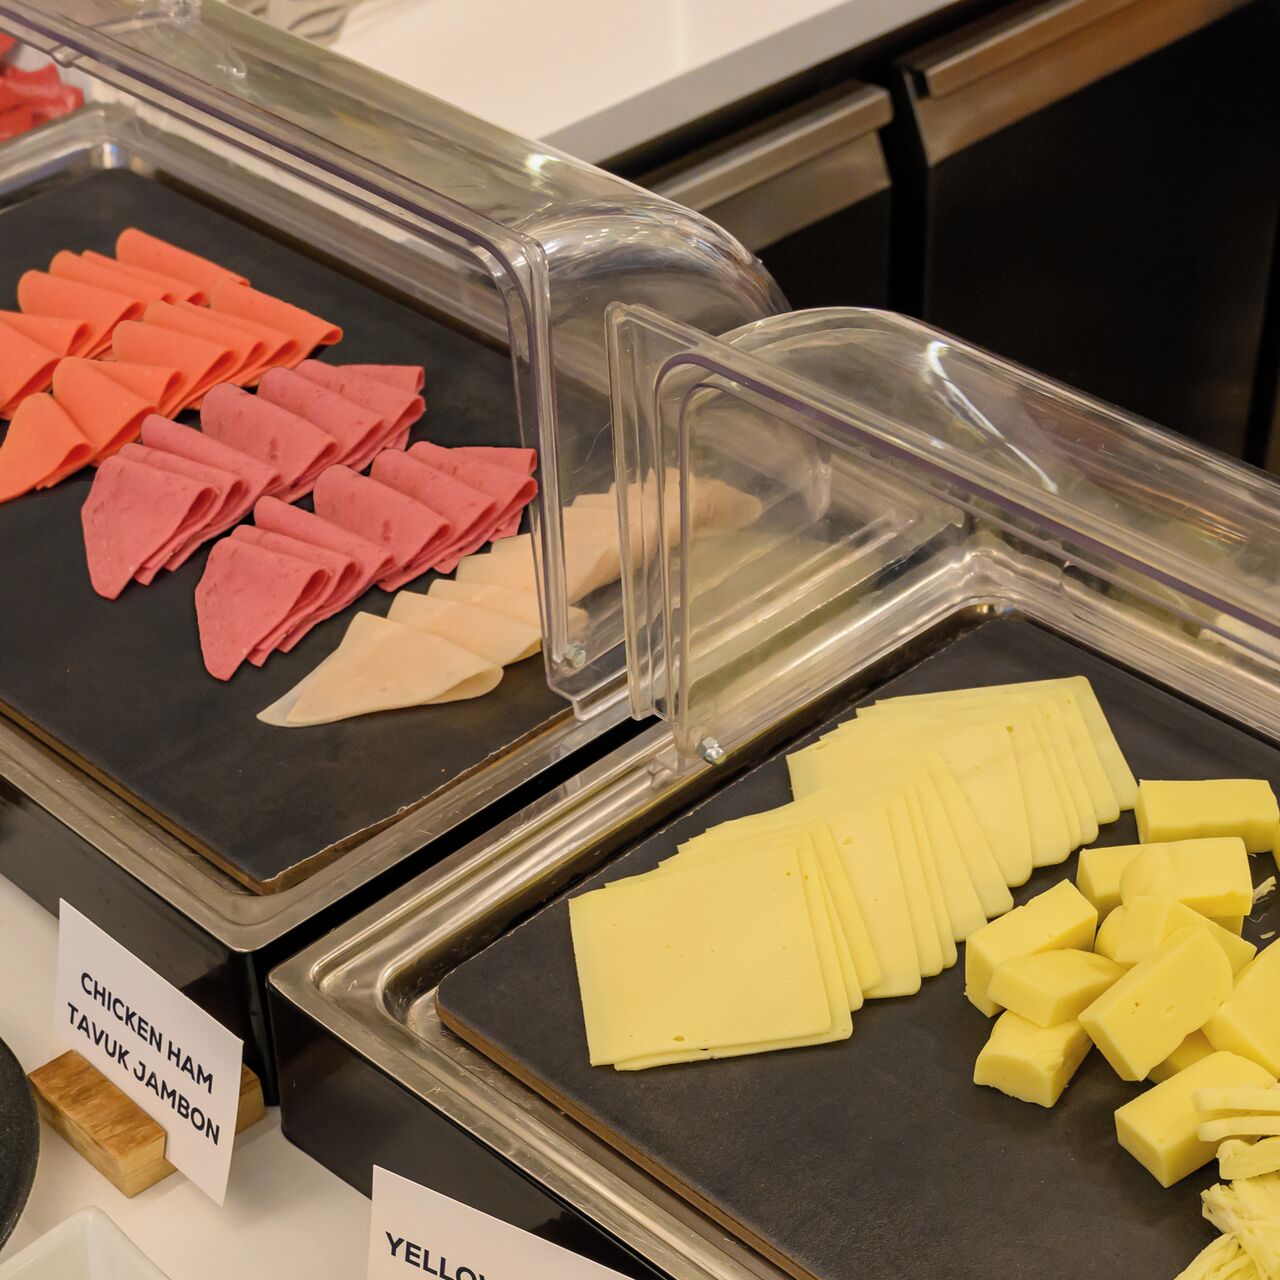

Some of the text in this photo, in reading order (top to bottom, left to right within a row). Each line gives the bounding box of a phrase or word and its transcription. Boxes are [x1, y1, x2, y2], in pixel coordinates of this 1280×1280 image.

[68, 1002, 219, 1145] TAVUK JAMBON
[81, 973, 213, 1094] CHICKEN HAM
